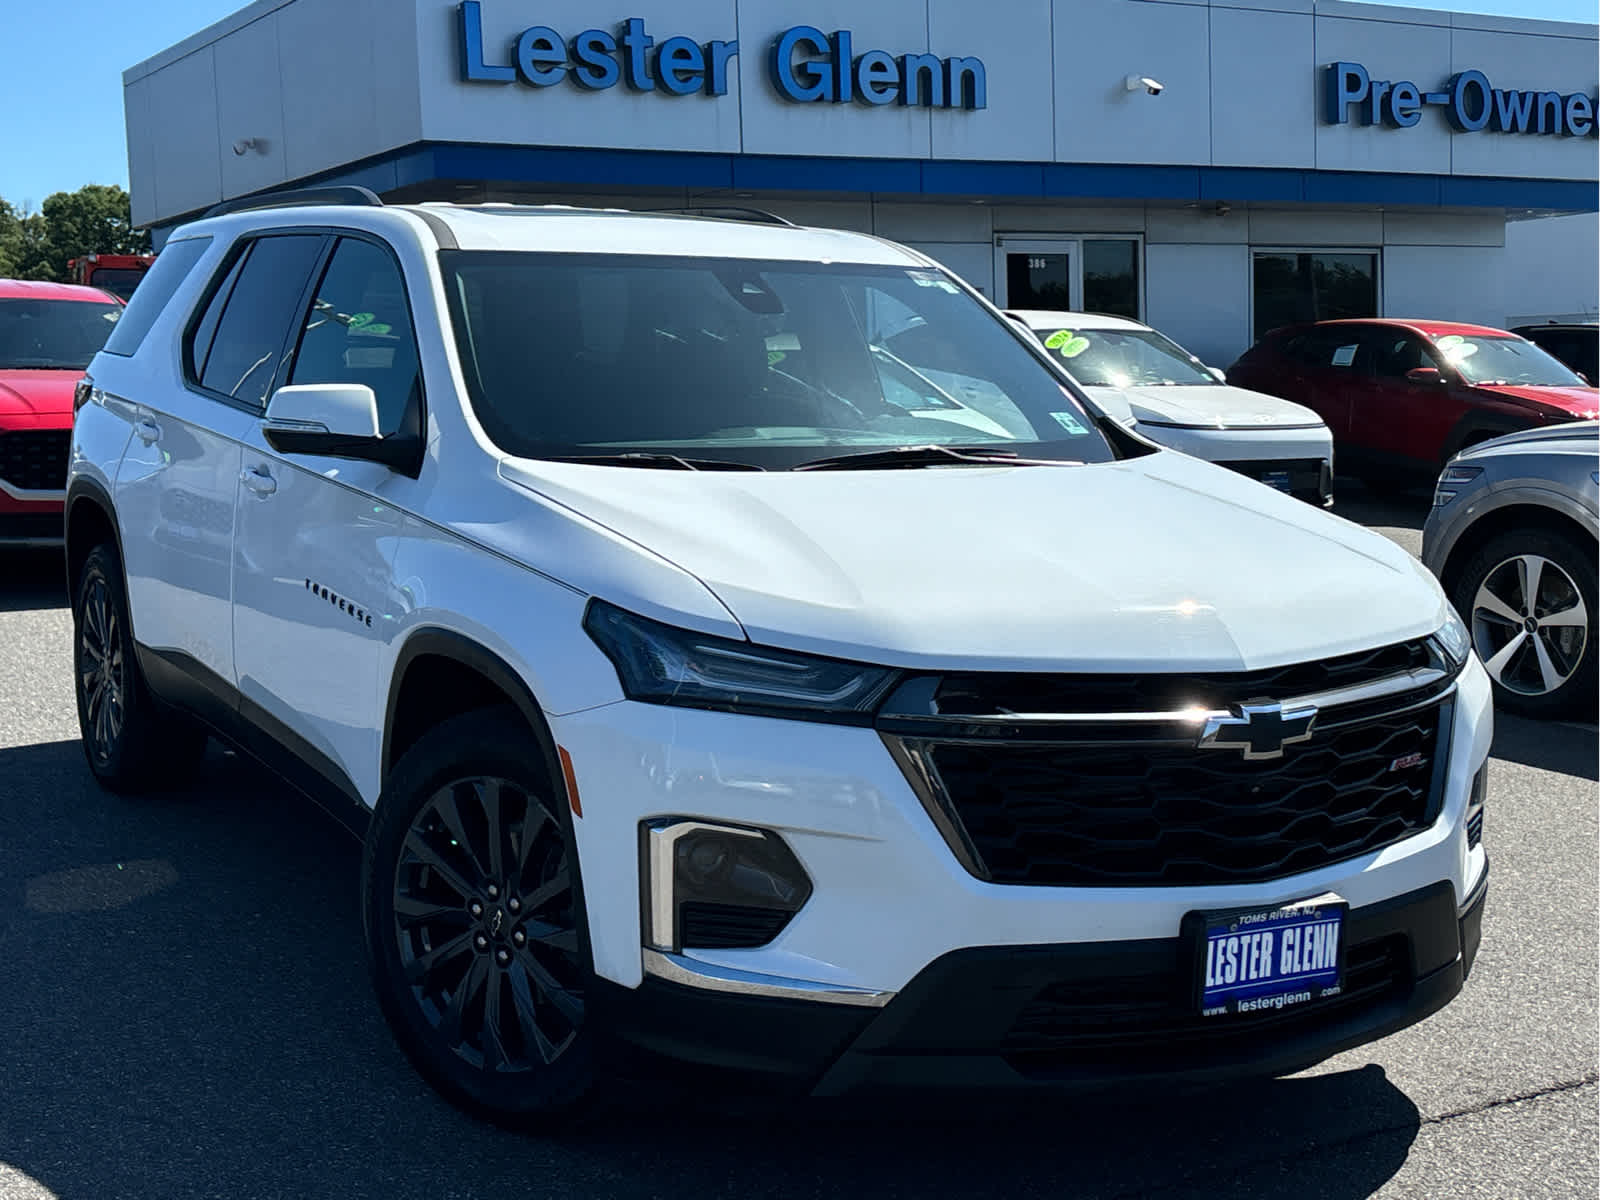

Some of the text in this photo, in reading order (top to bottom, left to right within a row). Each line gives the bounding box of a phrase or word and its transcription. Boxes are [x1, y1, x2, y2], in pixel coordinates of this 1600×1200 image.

[457, 1, 987, 110] Lester Glenn
[1327, 61, 1598, 137] Pre-Owne
[305, 577, 373, 628] TRAVERSE
[1239, 912, 1267, 924] TOMS
[1302, 905, 1316, 916] NJ
[1205, 922, 1340, 988] LESTER GLENN
[1203, 985, 1341, 1017] www. lesterglenn .com
